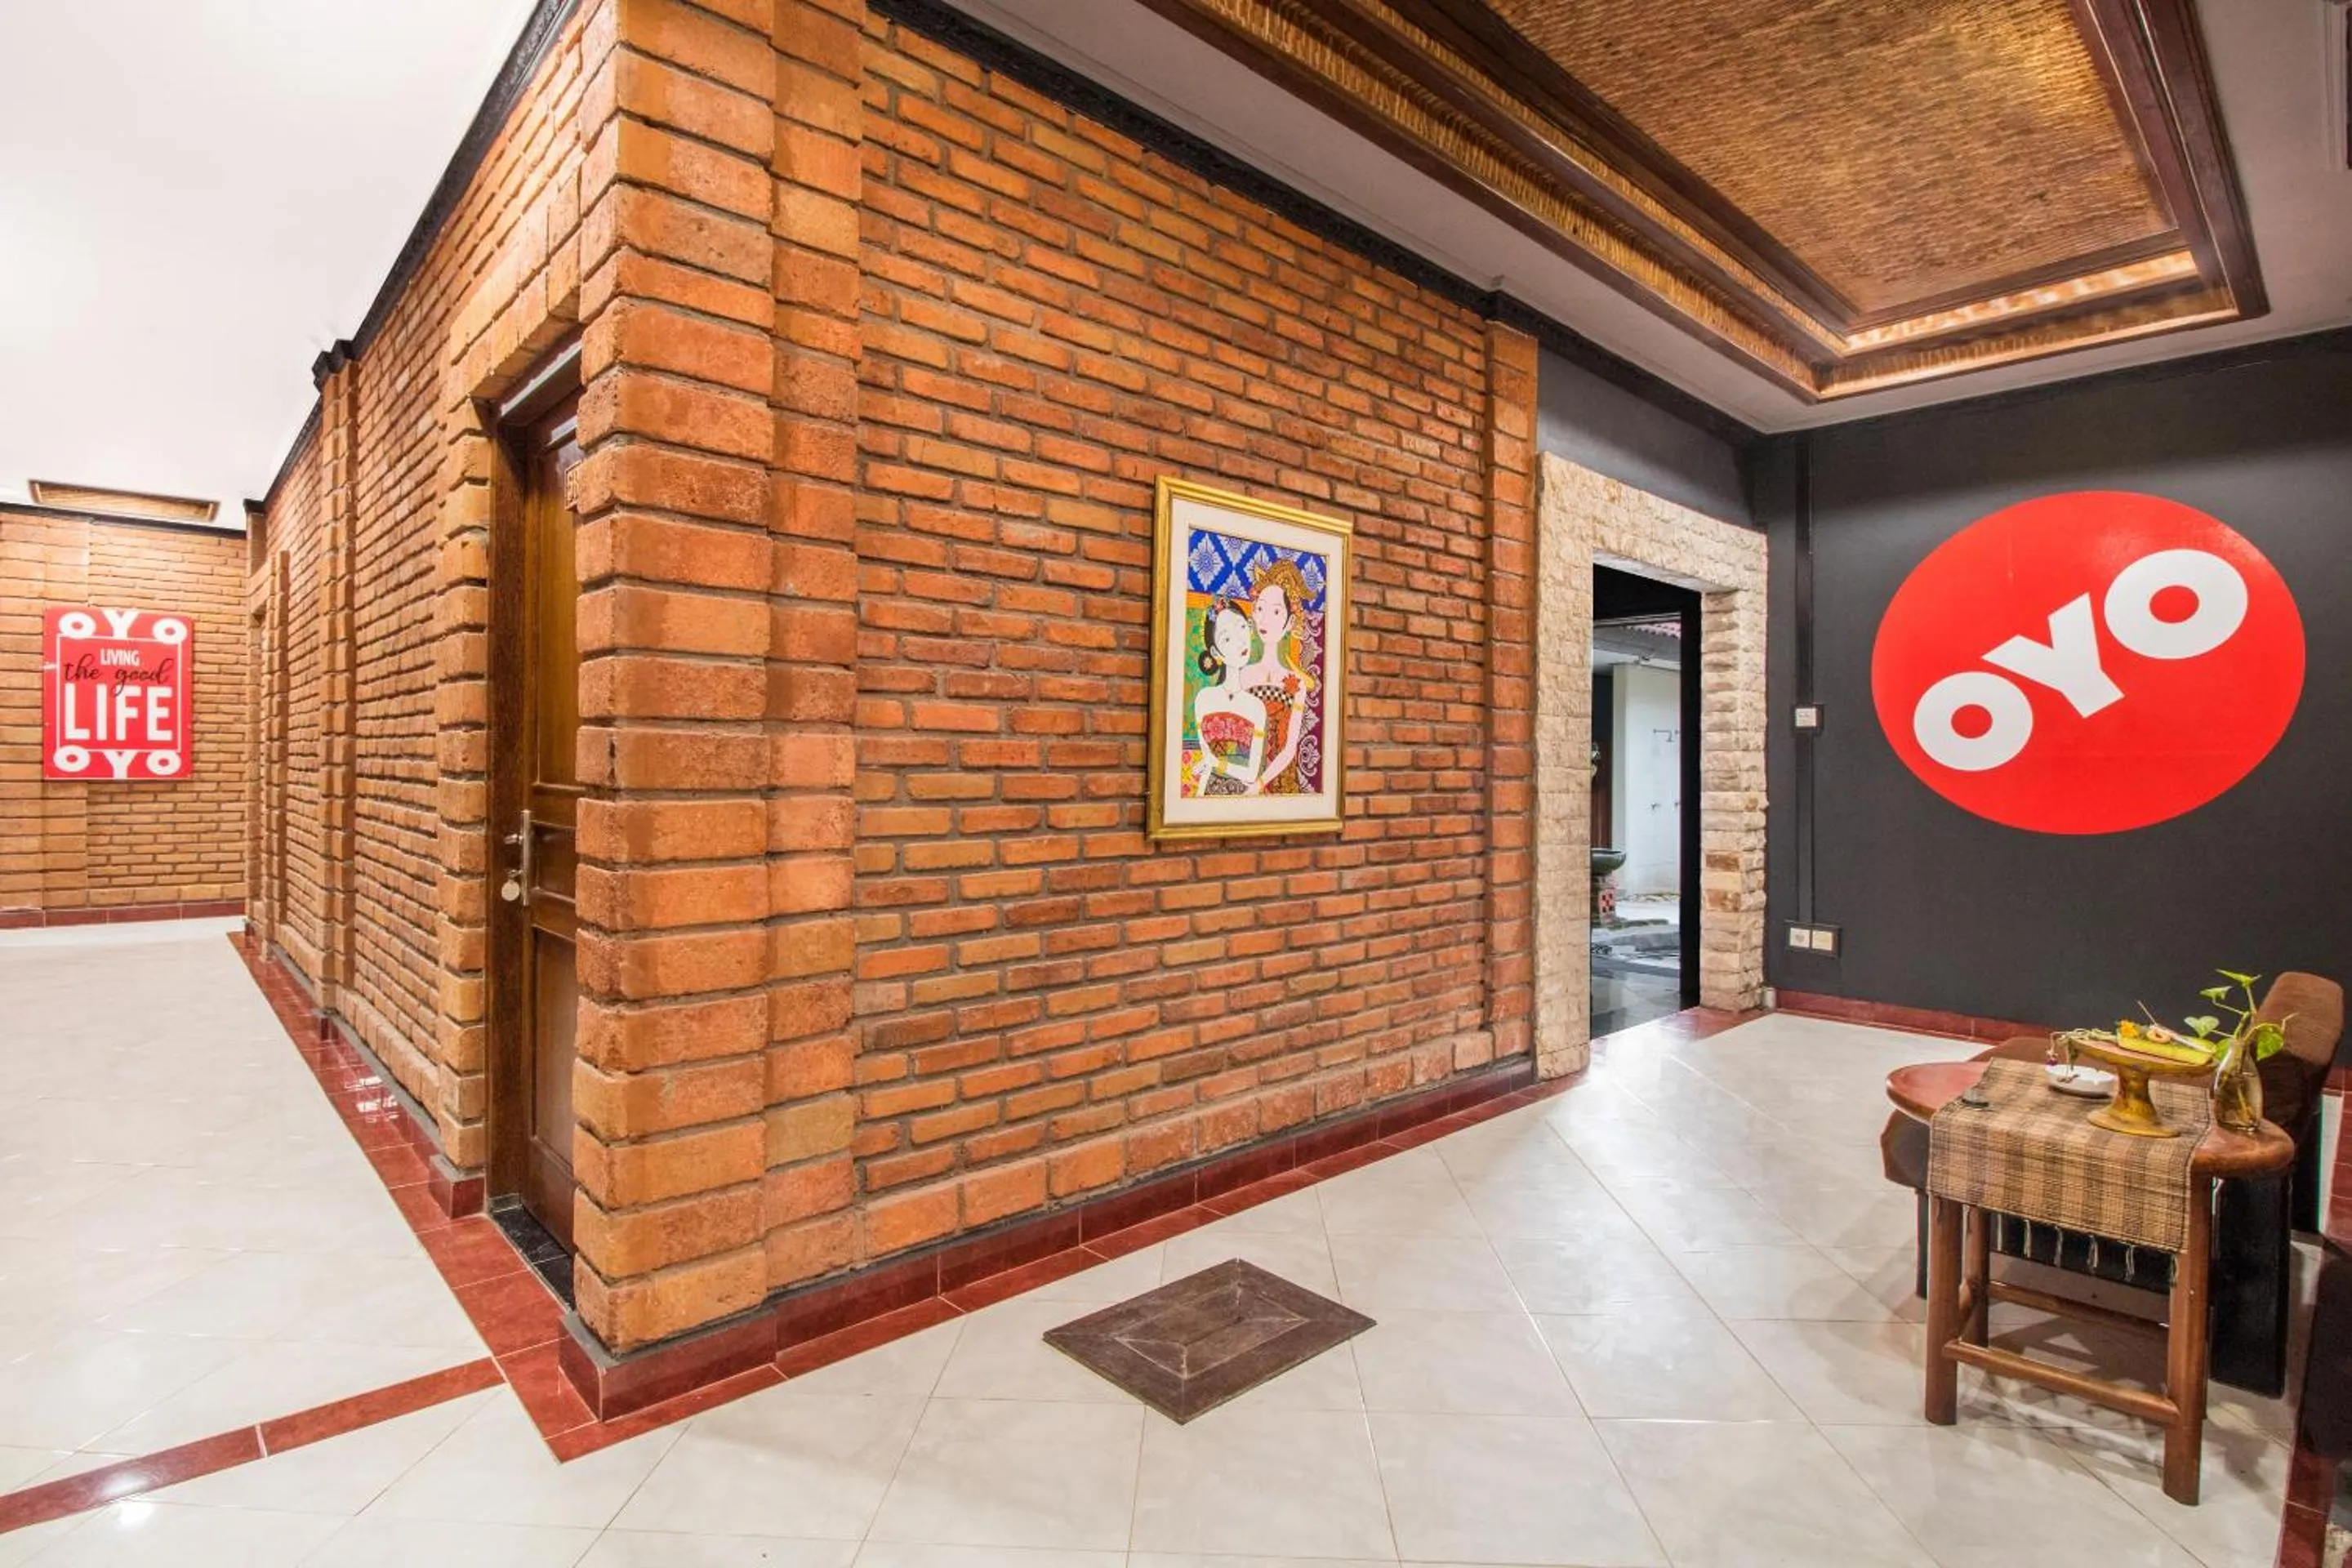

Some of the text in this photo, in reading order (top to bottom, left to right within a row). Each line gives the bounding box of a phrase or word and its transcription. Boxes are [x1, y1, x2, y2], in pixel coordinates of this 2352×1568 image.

[59, 608, 187, 644] OYO
[64, 653, 174, 696] the good
[100, 648, 140, 666] LIVING
[1913, 548, 2248, 772] OYO
[64, 683, 172, 742] LIFE
[53, 745, 181, 779] OYO
